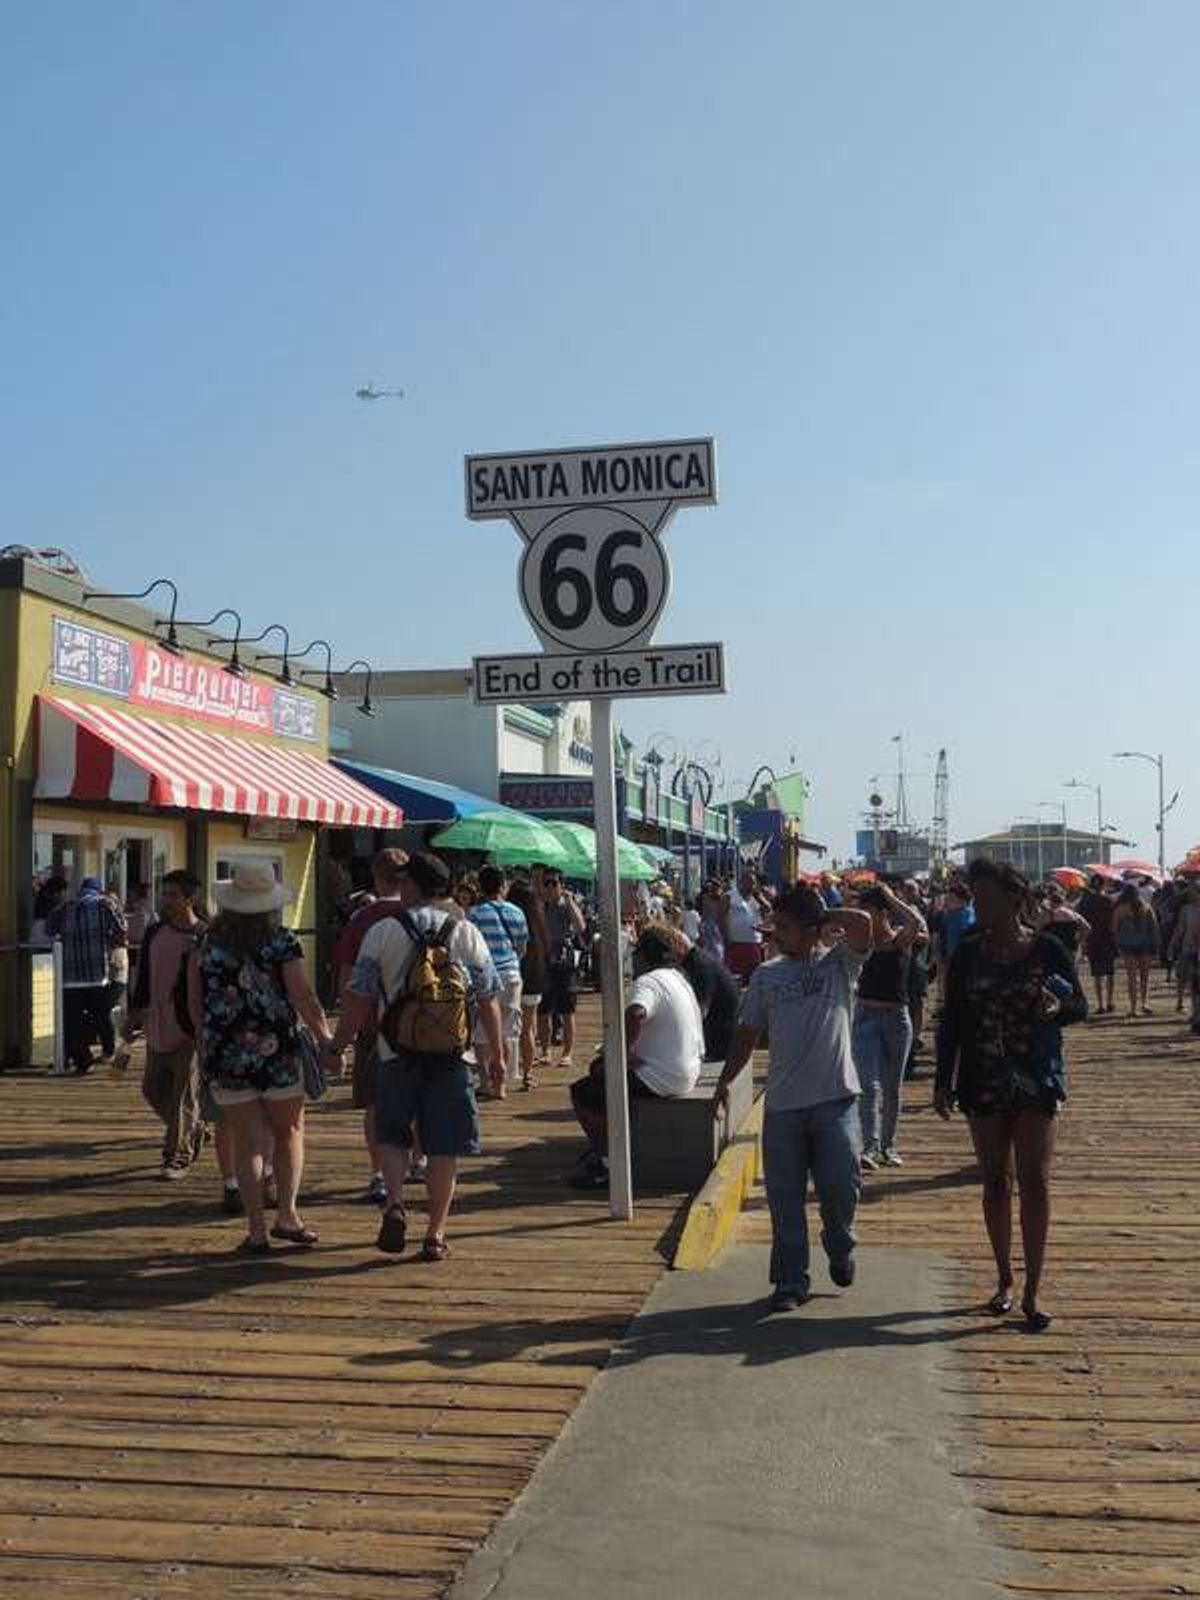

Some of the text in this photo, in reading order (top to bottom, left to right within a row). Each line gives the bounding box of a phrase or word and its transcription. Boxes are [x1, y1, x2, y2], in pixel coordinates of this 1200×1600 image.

[474, 453, 705, 503] SANTA MONICA
[540, 530, 648, 631] 66
[484, 654, 713, 693] End of the Trail
